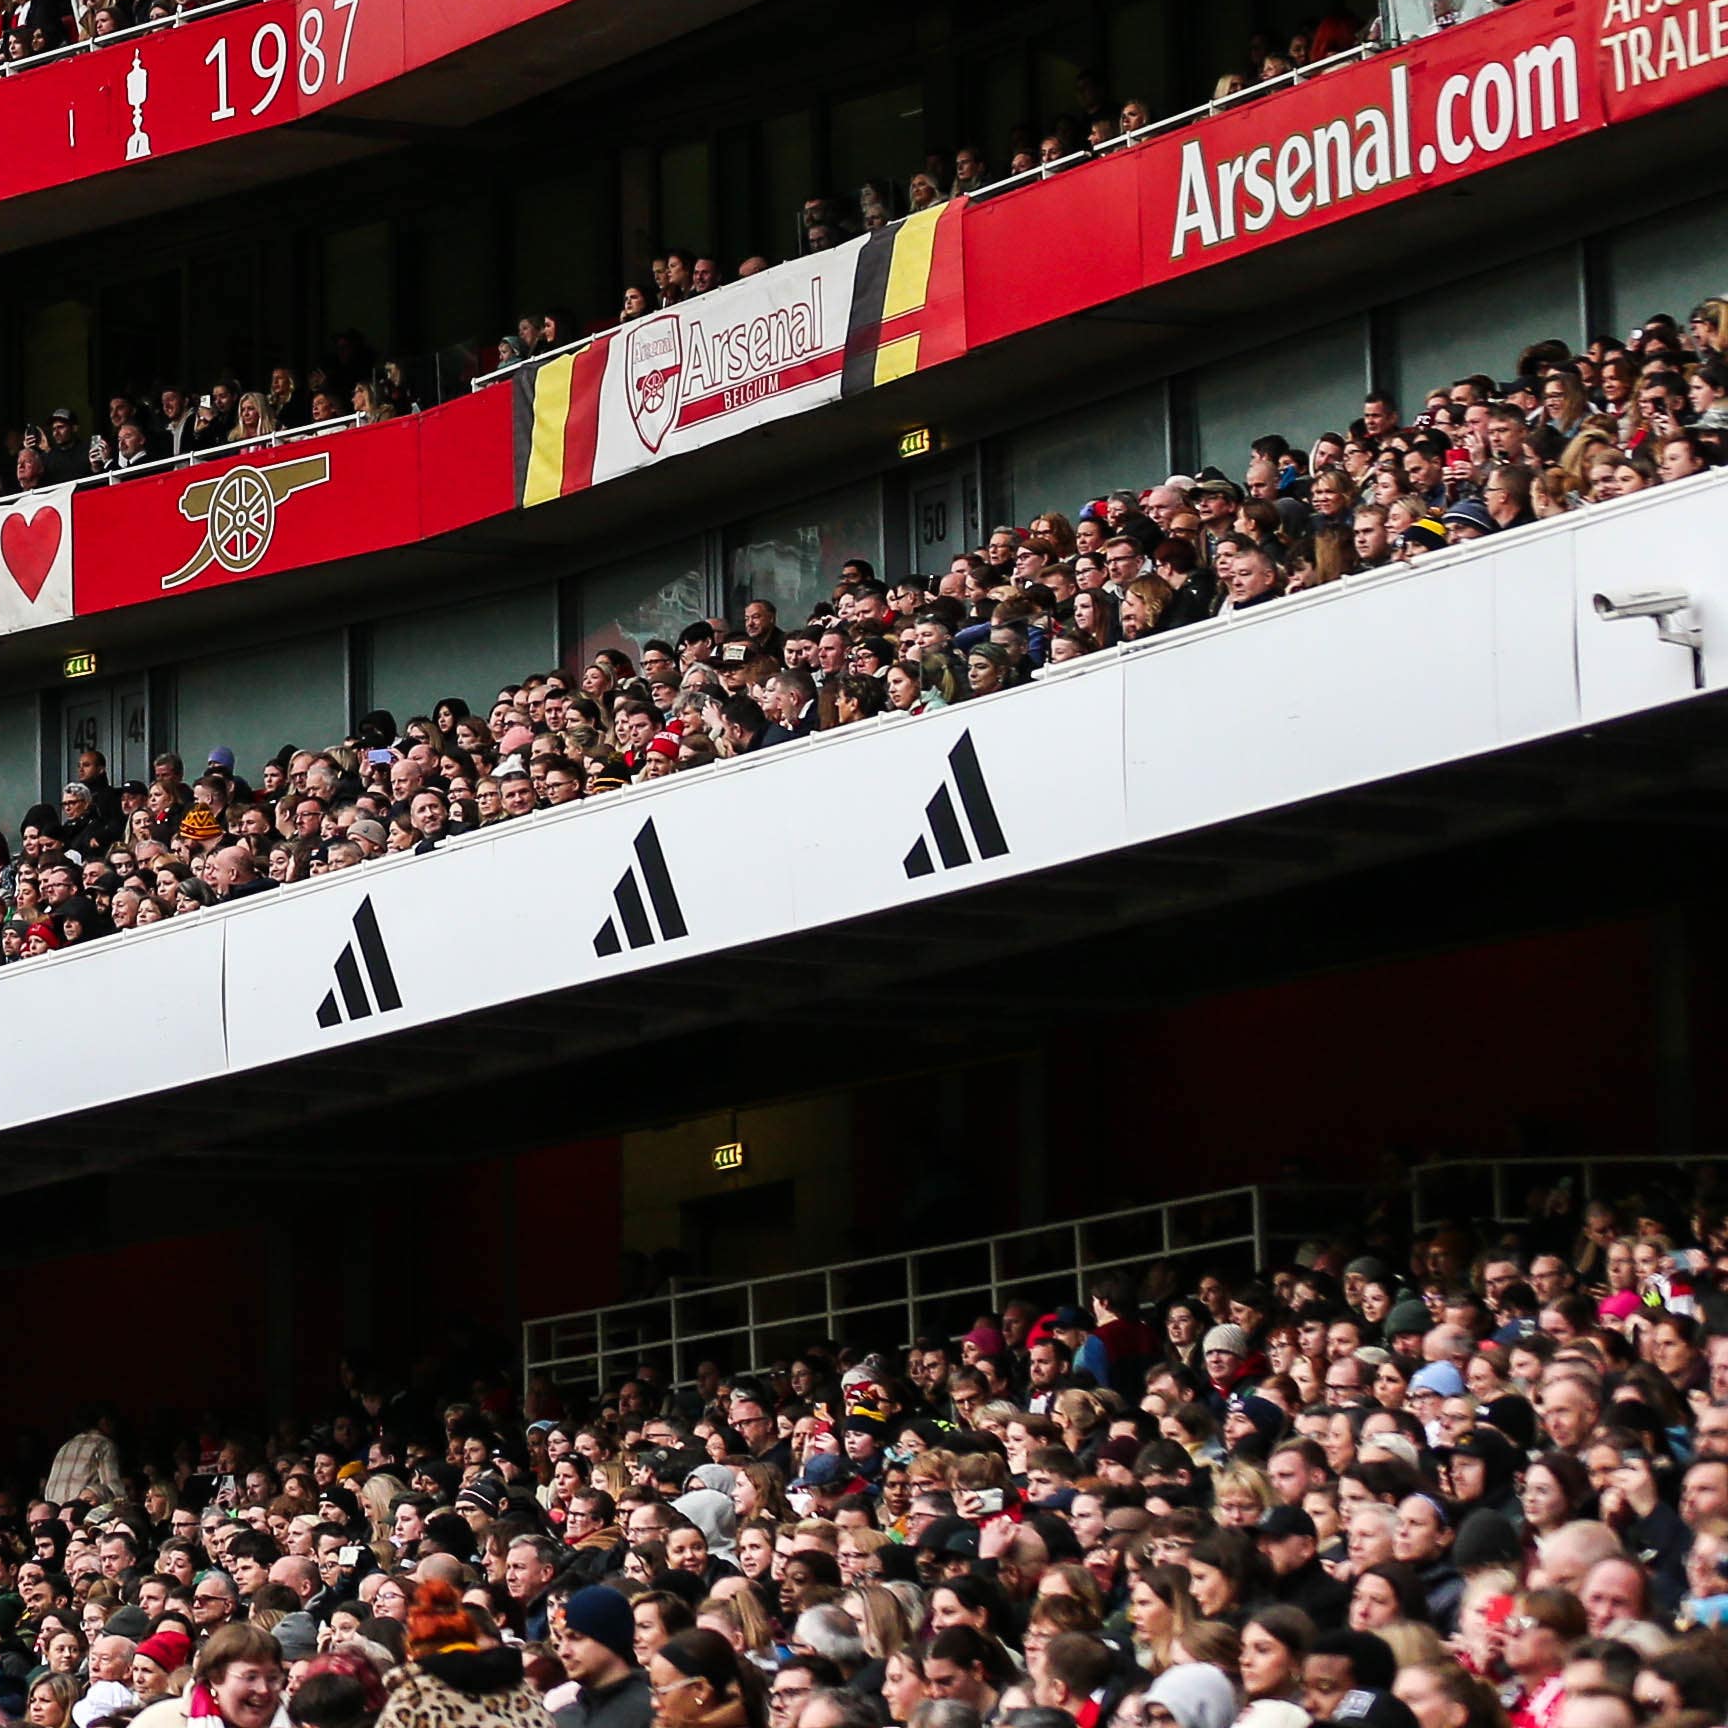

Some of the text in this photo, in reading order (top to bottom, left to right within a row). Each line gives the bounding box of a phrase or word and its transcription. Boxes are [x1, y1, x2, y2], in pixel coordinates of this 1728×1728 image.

[1170, 35, 1580, 259] Arsenal.com
[682, 276, 824, 397] Arsenal
[723, 374, 780, 410] BELGIUM
[74, 717, 98, 753] 49
